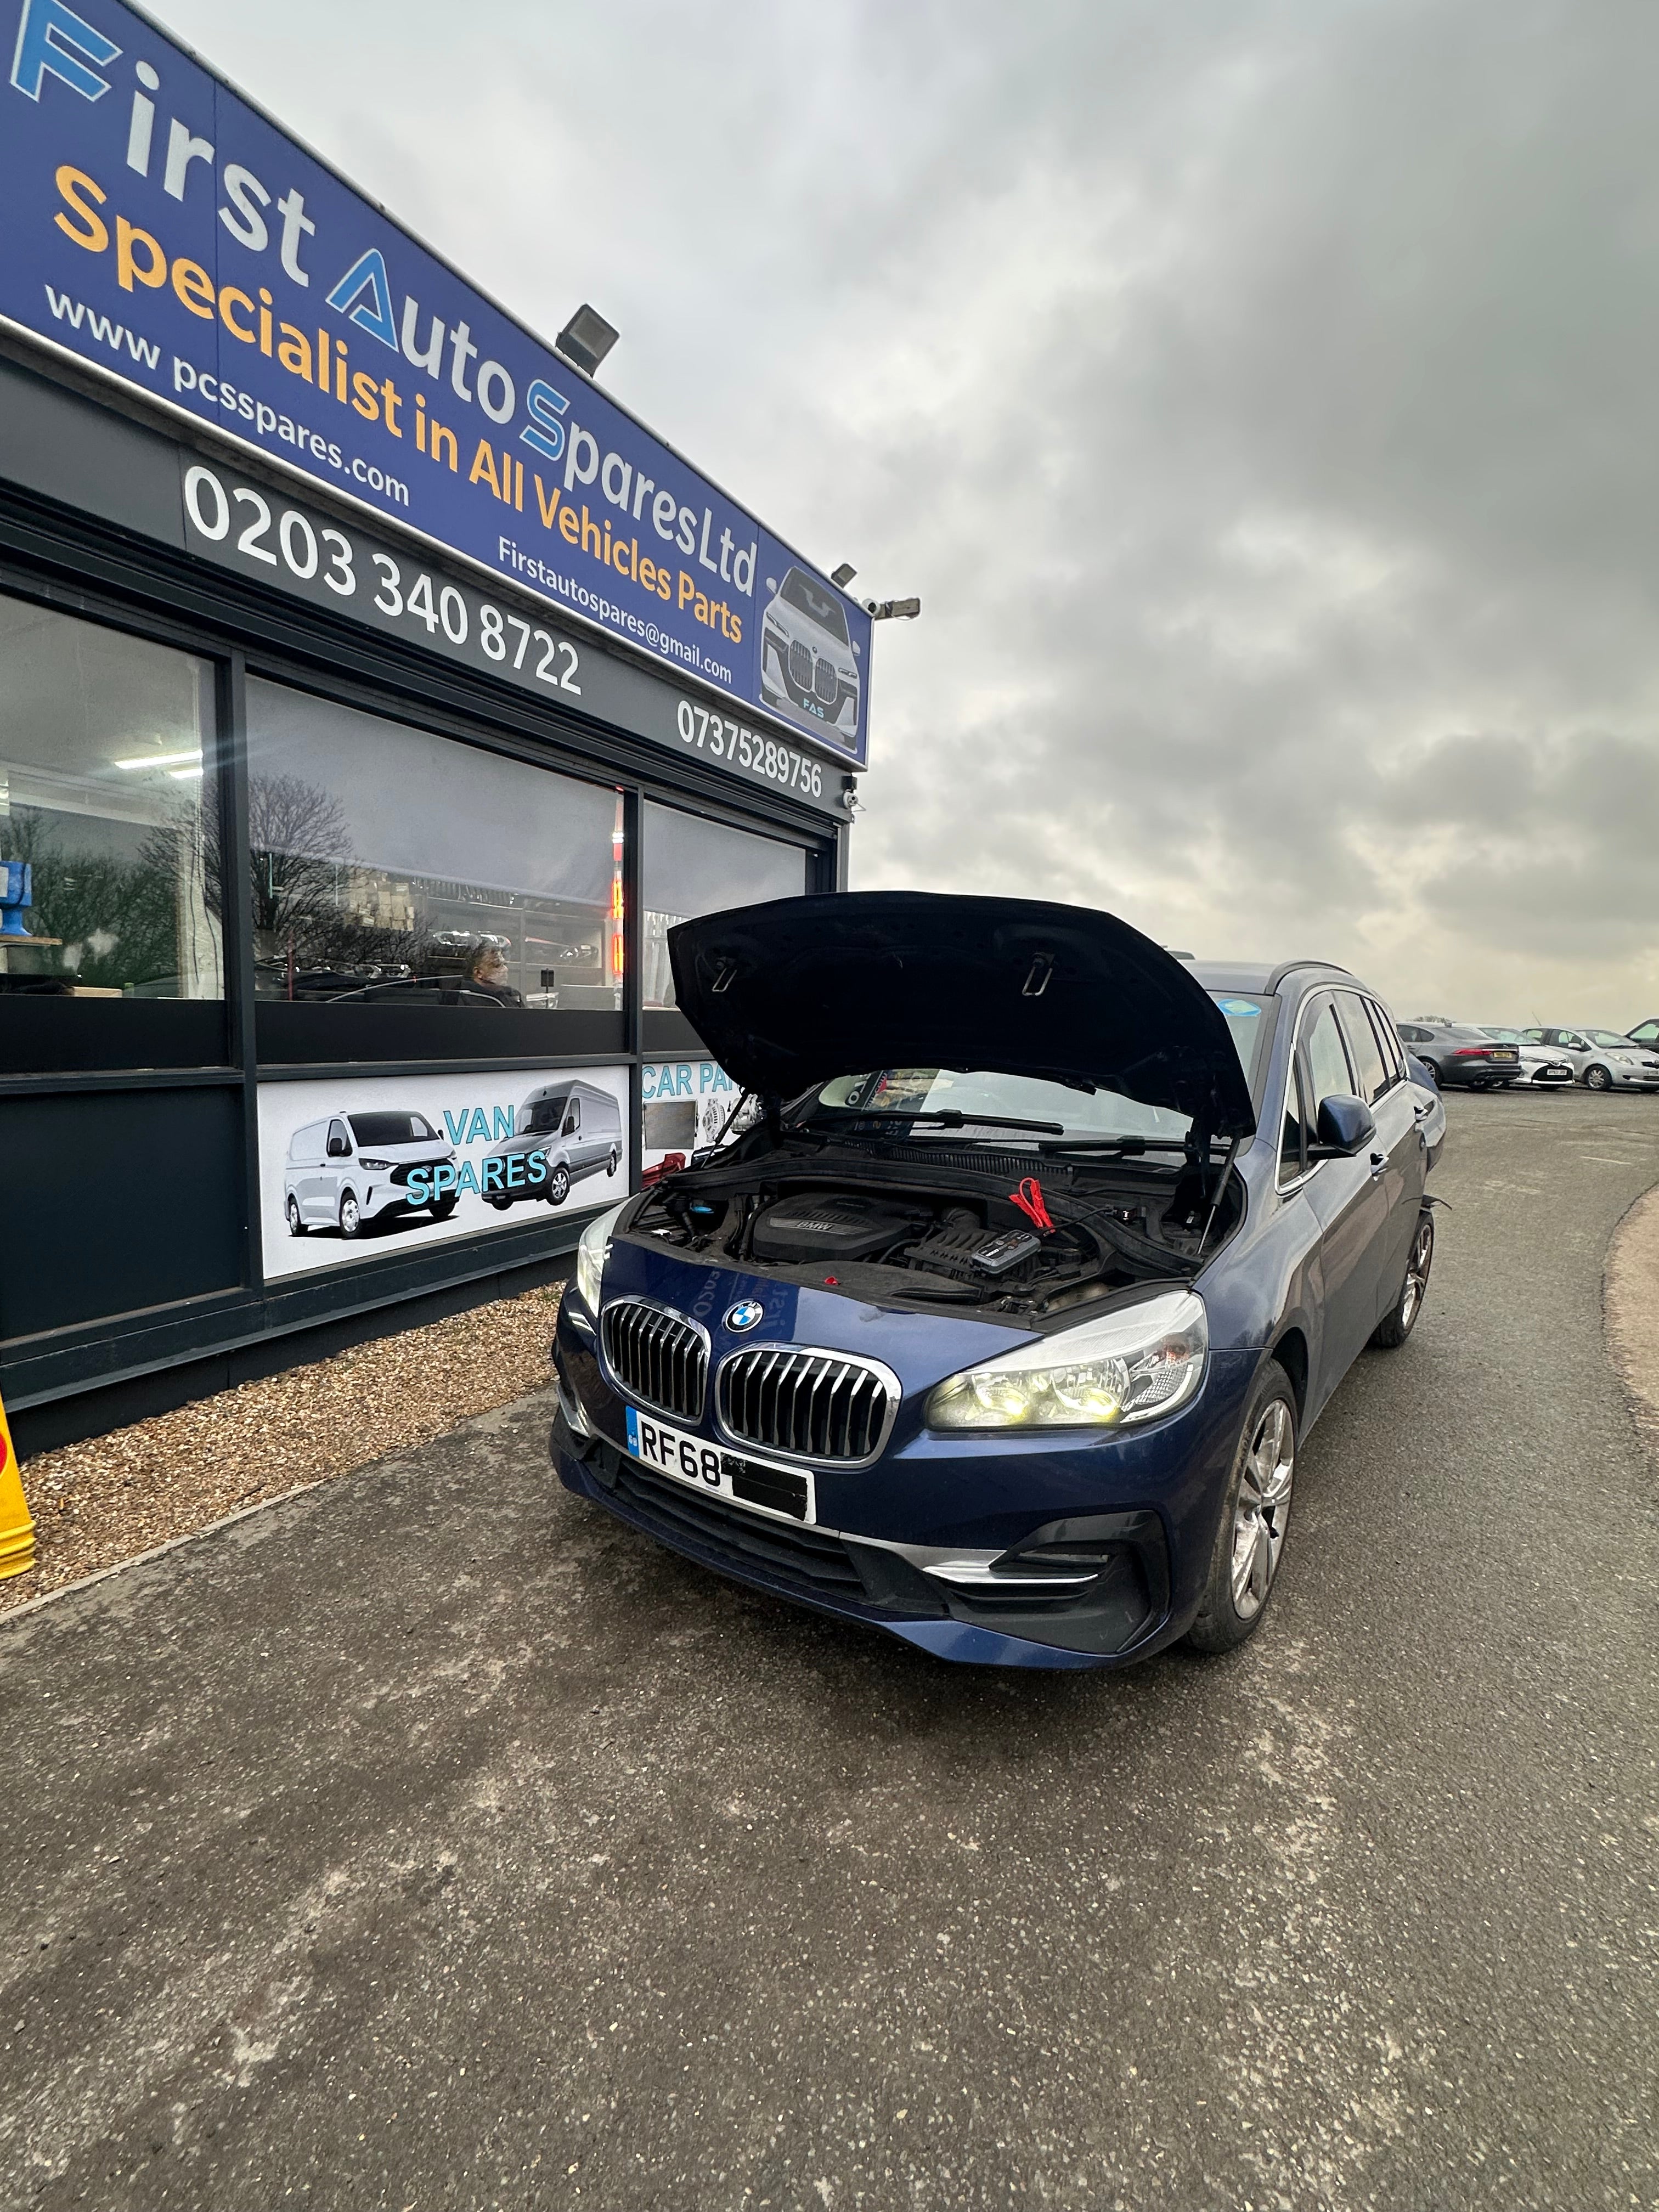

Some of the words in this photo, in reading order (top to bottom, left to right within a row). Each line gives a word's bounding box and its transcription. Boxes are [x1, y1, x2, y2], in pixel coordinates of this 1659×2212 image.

[10, 0, 315, 287] First
[325, 248, 516, 425] Auto
[45, 284, 161, 370] www
[173, 356, 410, 506] pcsspares.com
[54, 165, 403, 438] Specialist
[415, 393, 458, 473] in
[469, 439, 523, 512] All
[533, 473, 672, 601] Vehicles
[678, 570, 742, 644] Parts
[184, 465, 357, 596] 0203
[371, 552, 468, 645] 340
[479, 604, 582, 696] 8722
[499, 535, 732, 685] Firstautospares@gmail.com
[677, 700, 822, 798] 07375289756
[803, 698, 825, 719] FAS
[642, 1064, 693, 1099] CAR
[443, 1105, 514, 1146] VAN
[405, 1150, 547, 1205] SPARES
[796, 1221, 833, 1231] BMW
[641, 1420, 721, 1487] RF68
